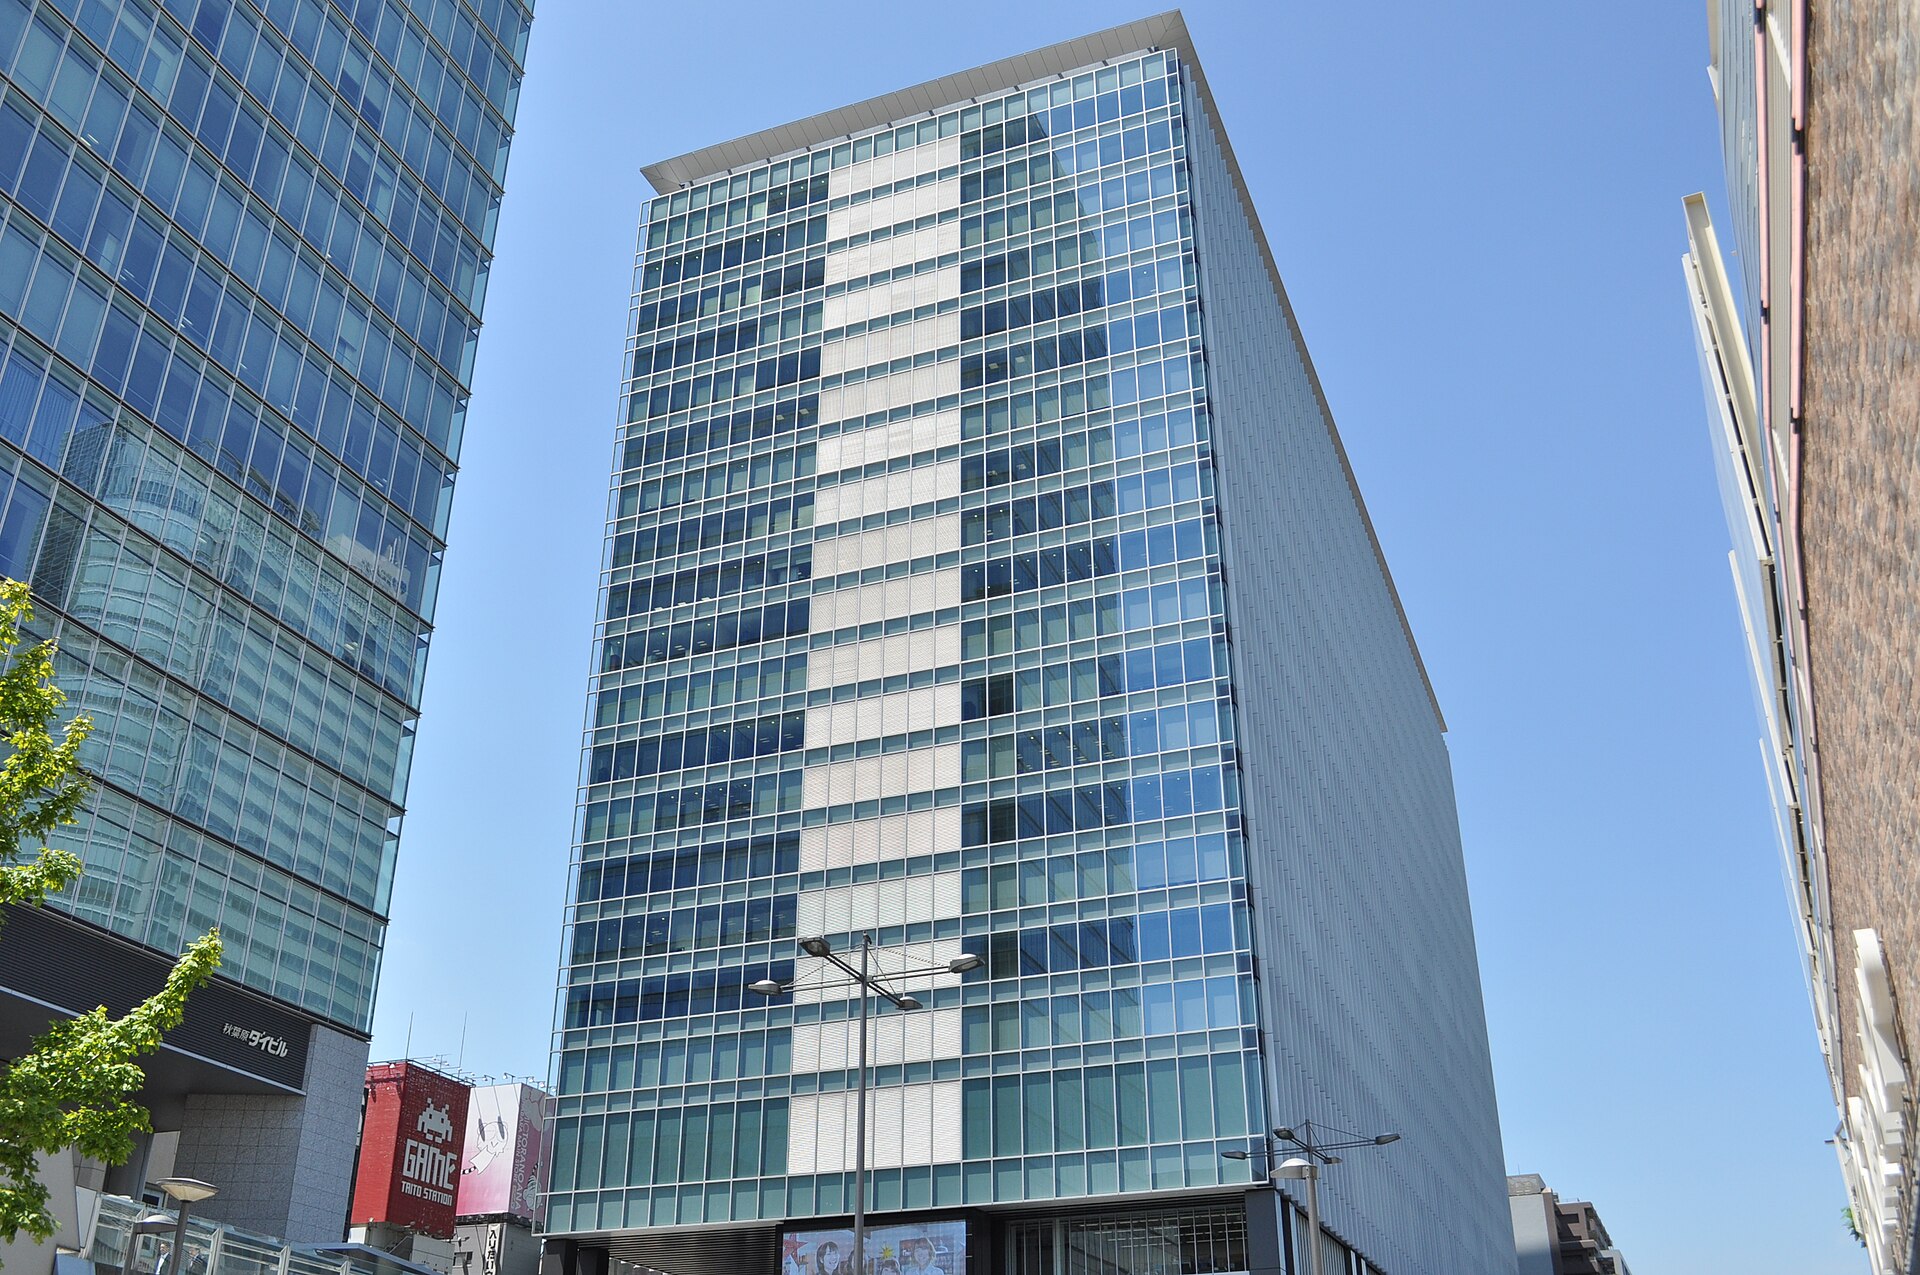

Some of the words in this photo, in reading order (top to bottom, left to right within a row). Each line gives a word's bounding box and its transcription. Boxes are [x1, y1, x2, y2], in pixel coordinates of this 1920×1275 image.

[223, 1023, 288, 1057] 秋葉原ダイビル
[403, 1139, 457, 1190] GAME
[401, 1181, 422, 1197] TAITO
[423, 1187, 453, 1206] STATION
